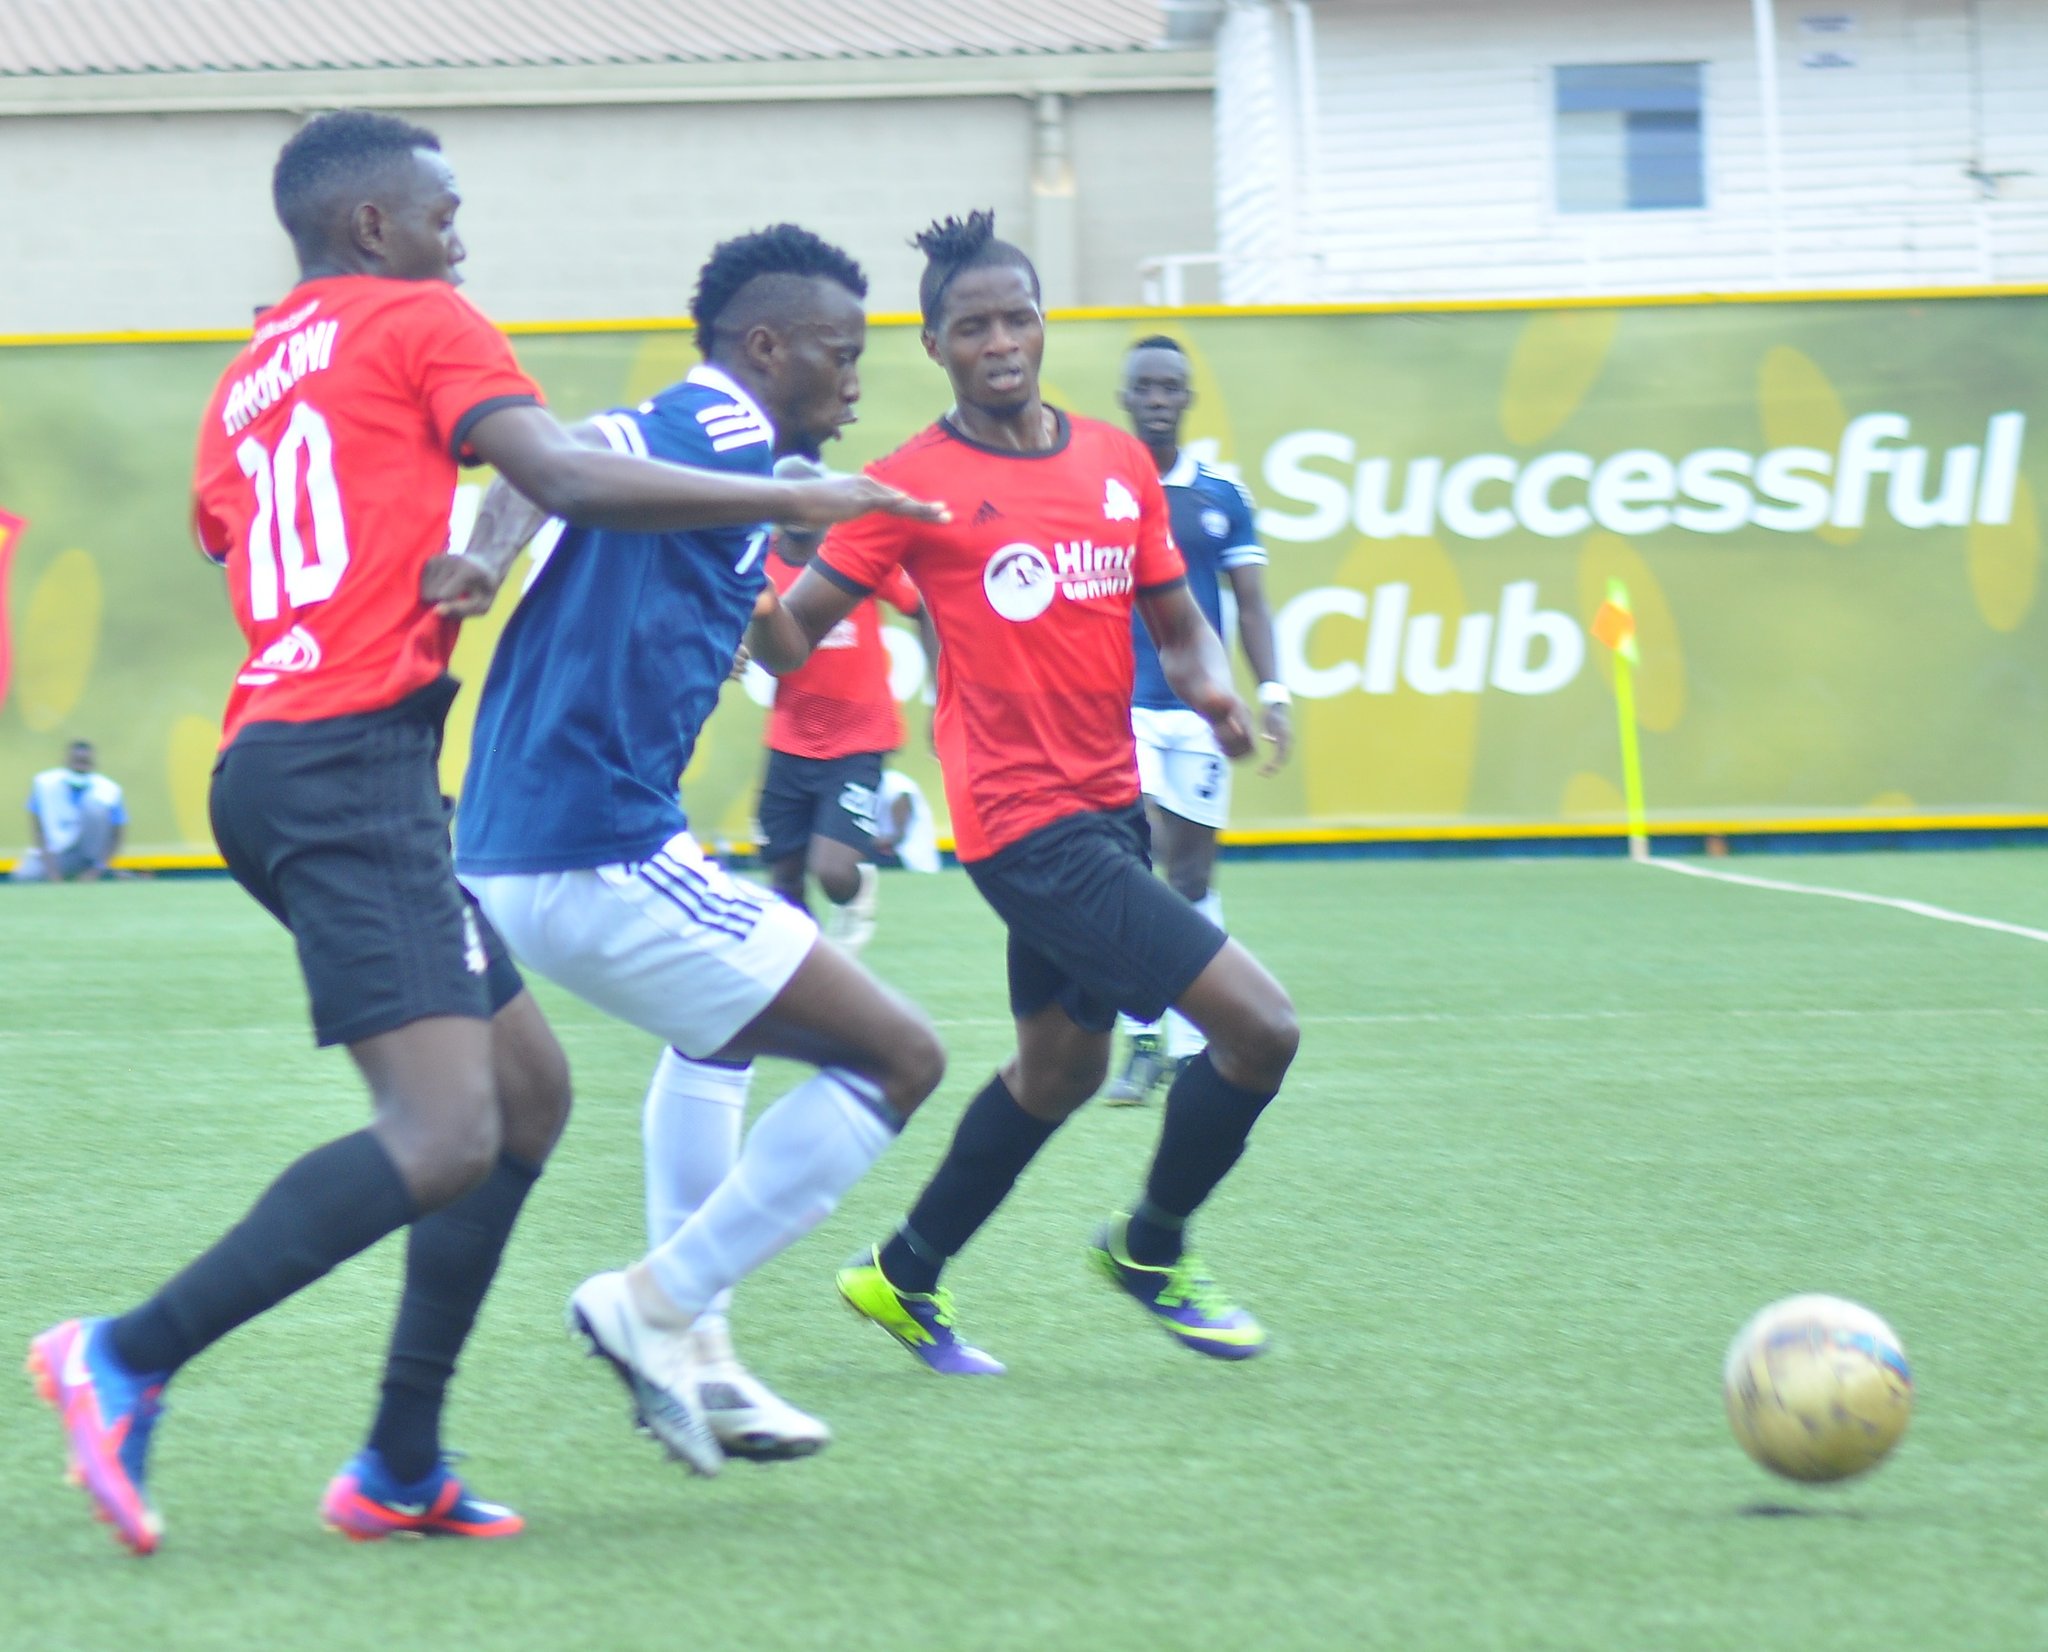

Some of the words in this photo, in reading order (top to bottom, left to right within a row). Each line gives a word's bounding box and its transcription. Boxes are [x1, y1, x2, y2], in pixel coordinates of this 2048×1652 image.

[235, 401, 350, 621] 10
[1256, 411, 2026, 542] Successful
[1272, 580, 1586, 700] Club
